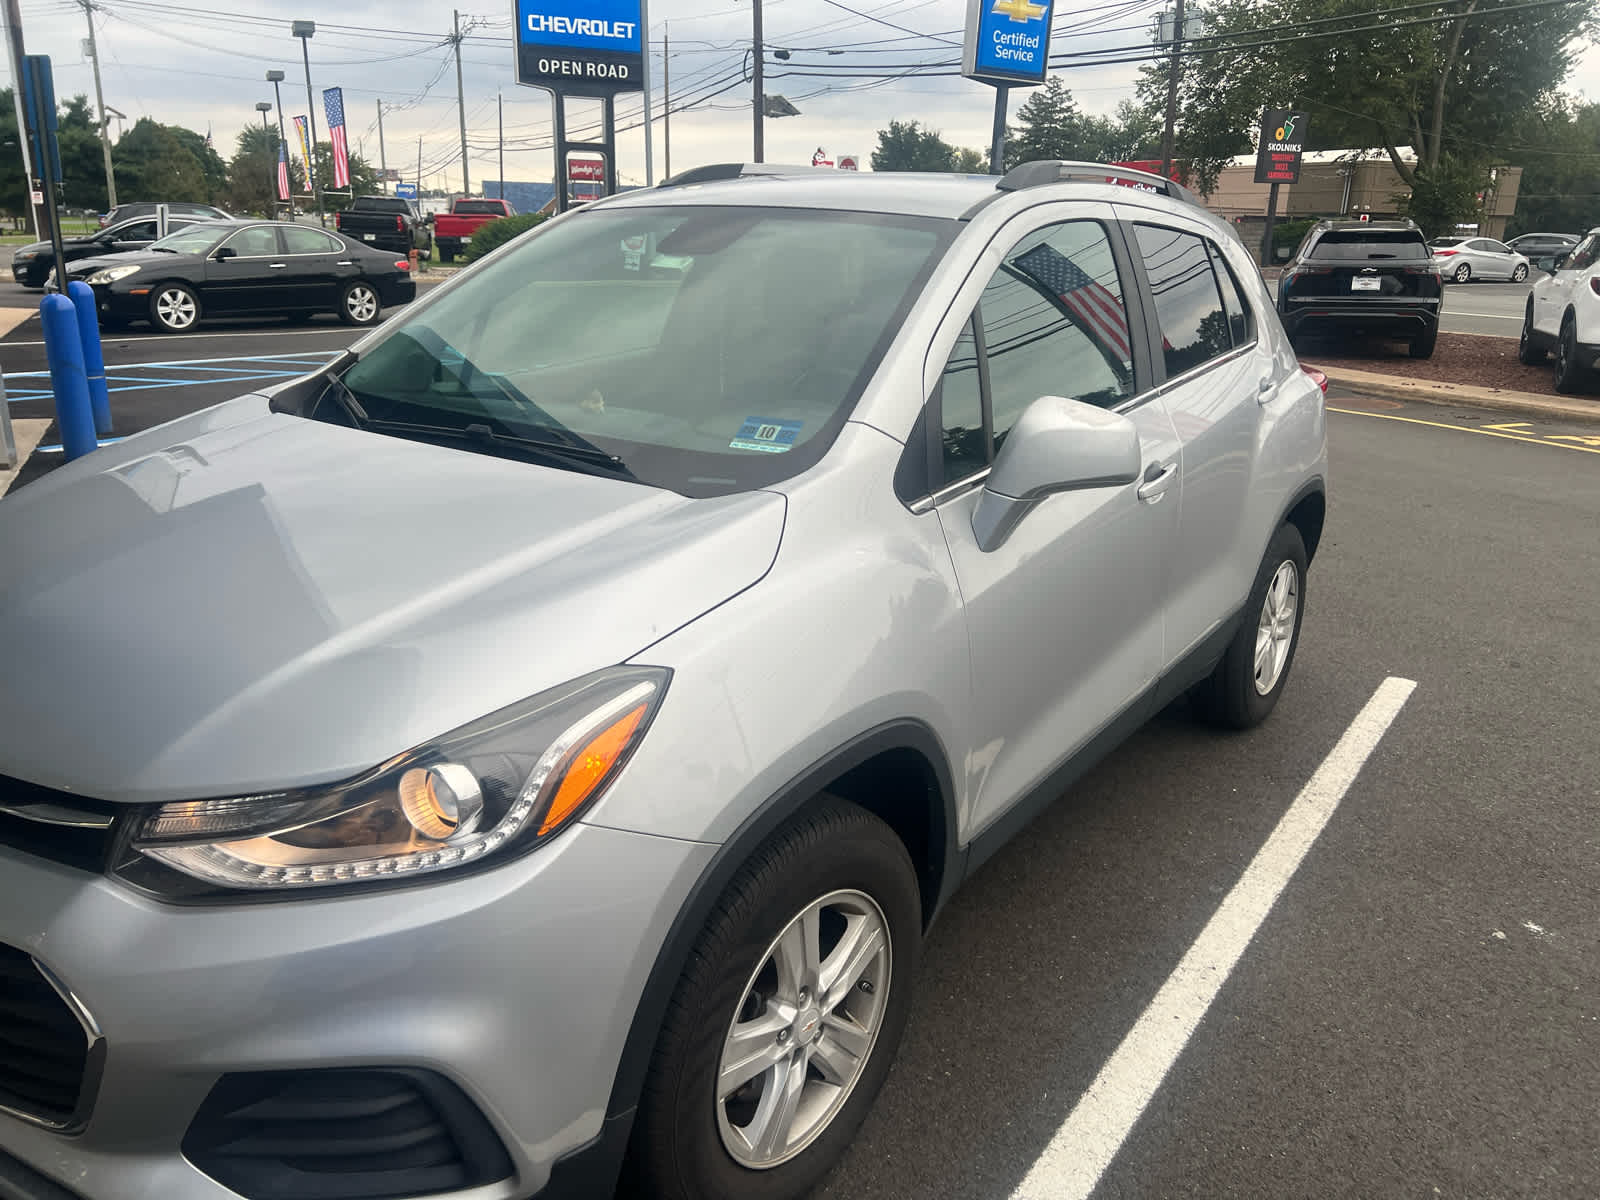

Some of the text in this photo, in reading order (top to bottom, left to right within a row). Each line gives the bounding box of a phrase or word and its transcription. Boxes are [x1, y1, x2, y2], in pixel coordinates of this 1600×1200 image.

[527, 14, 636, 39] CHEVROLET
[993, 29, 1040, 49] Certified
[995, 45, 1034, 62] Service
[538, 58, 629, 79] OPEN ROAD
[1267, 143, 1302, 153] SKOLNIKS
[757, 426, 777, 439] 10
